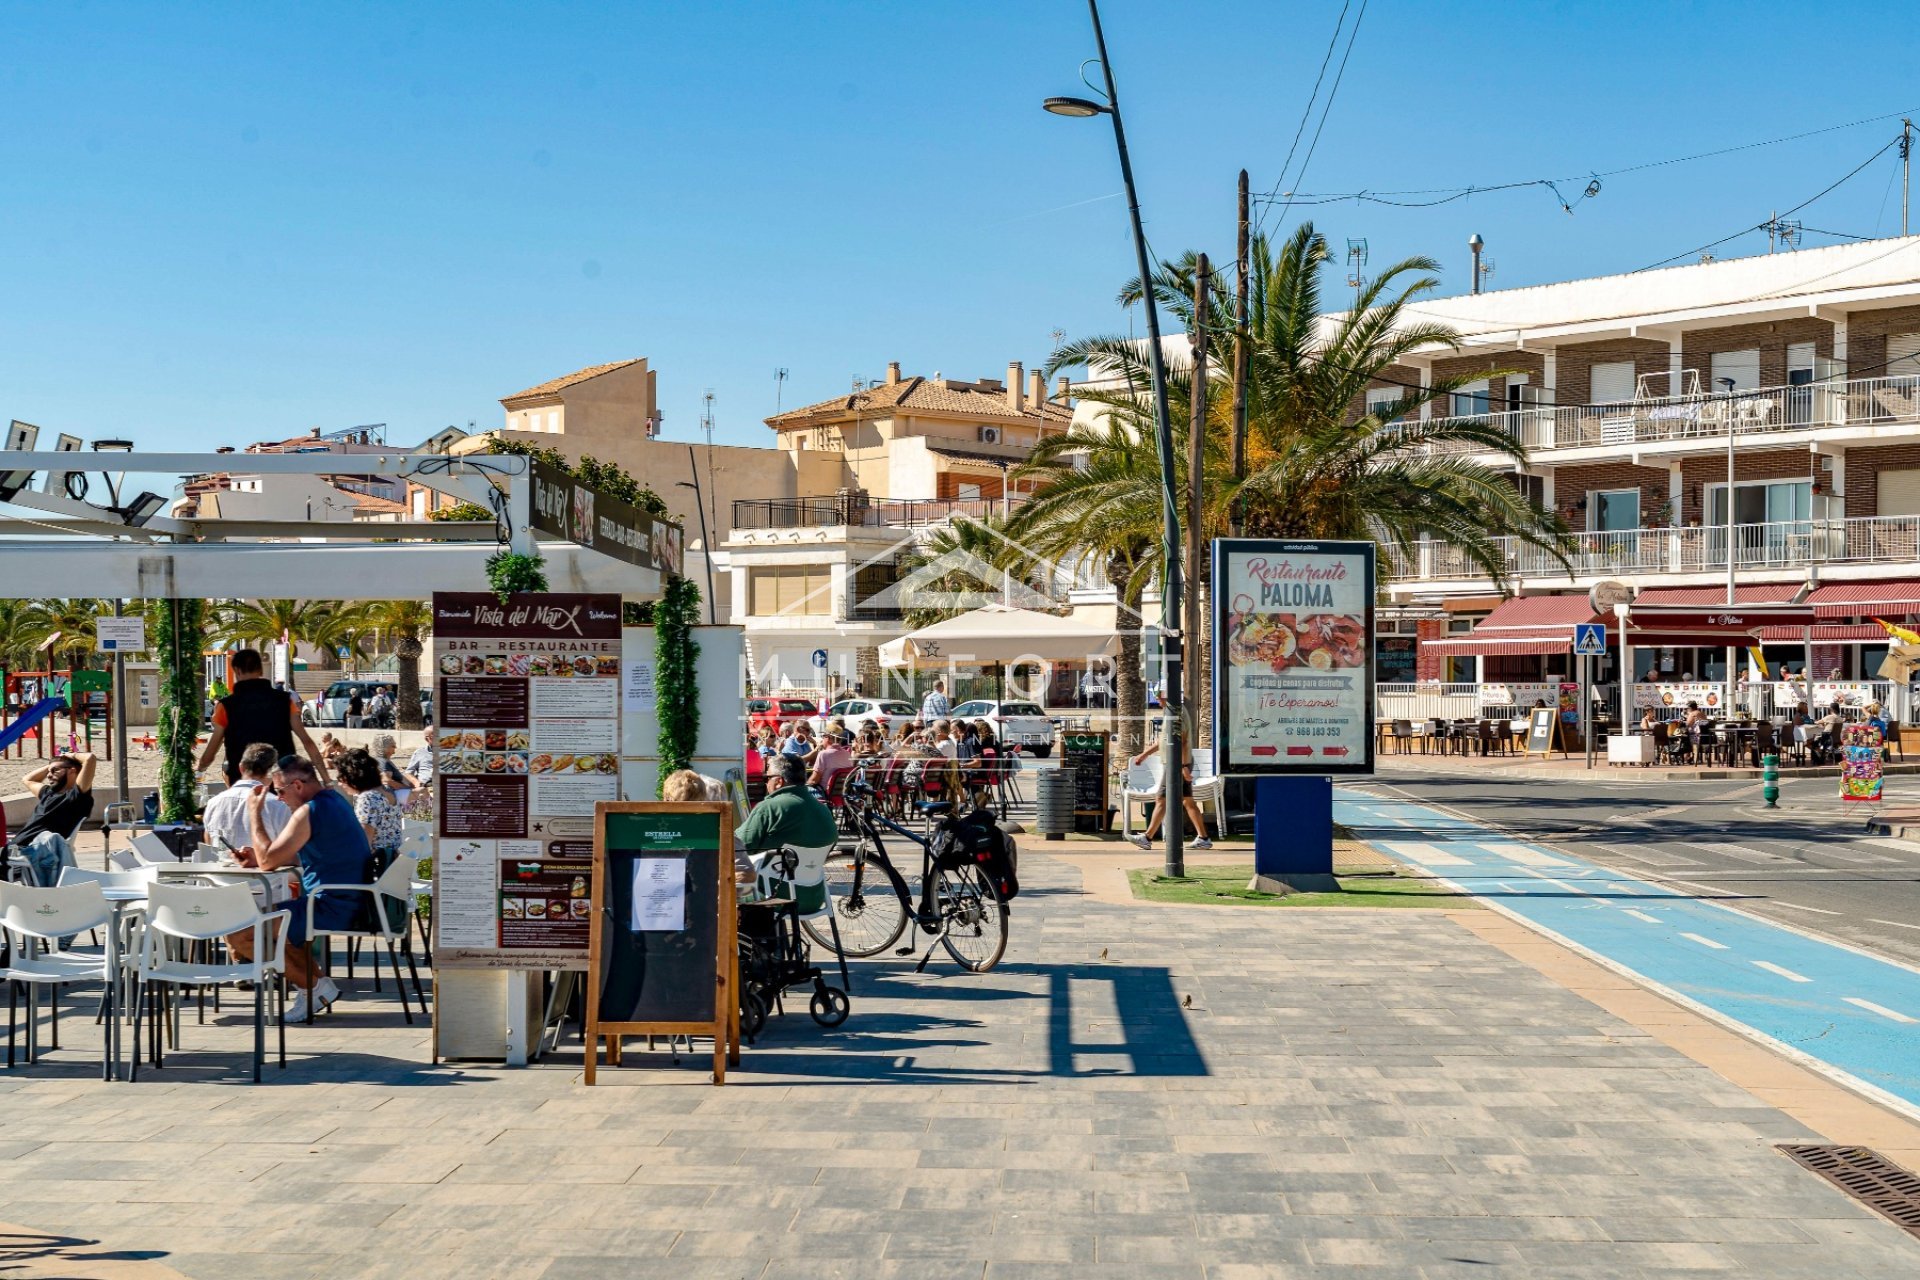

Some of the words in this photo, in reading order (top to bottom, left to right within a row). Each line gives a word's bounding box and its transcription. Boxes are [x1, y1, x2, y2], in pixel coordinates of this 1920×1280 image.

[1247, 558, 1347, 587] Restaurante
[1261, 583, 1334, 607] PALOMA
[474, 605, 505, 627] Vista
[508, 605, 531, 627] del
[531, 605, 562, 627] Mar
[449, 641, 478, 650] BAR
[498, 641, 609, 652] RESTAURANTE
[1302, 680, 1317, 689] para
[1280, 692, 1340, 711] Esperamos!
[1296, 727, 1311, 737] 968
[1326, 727, 1341, 737] 353
